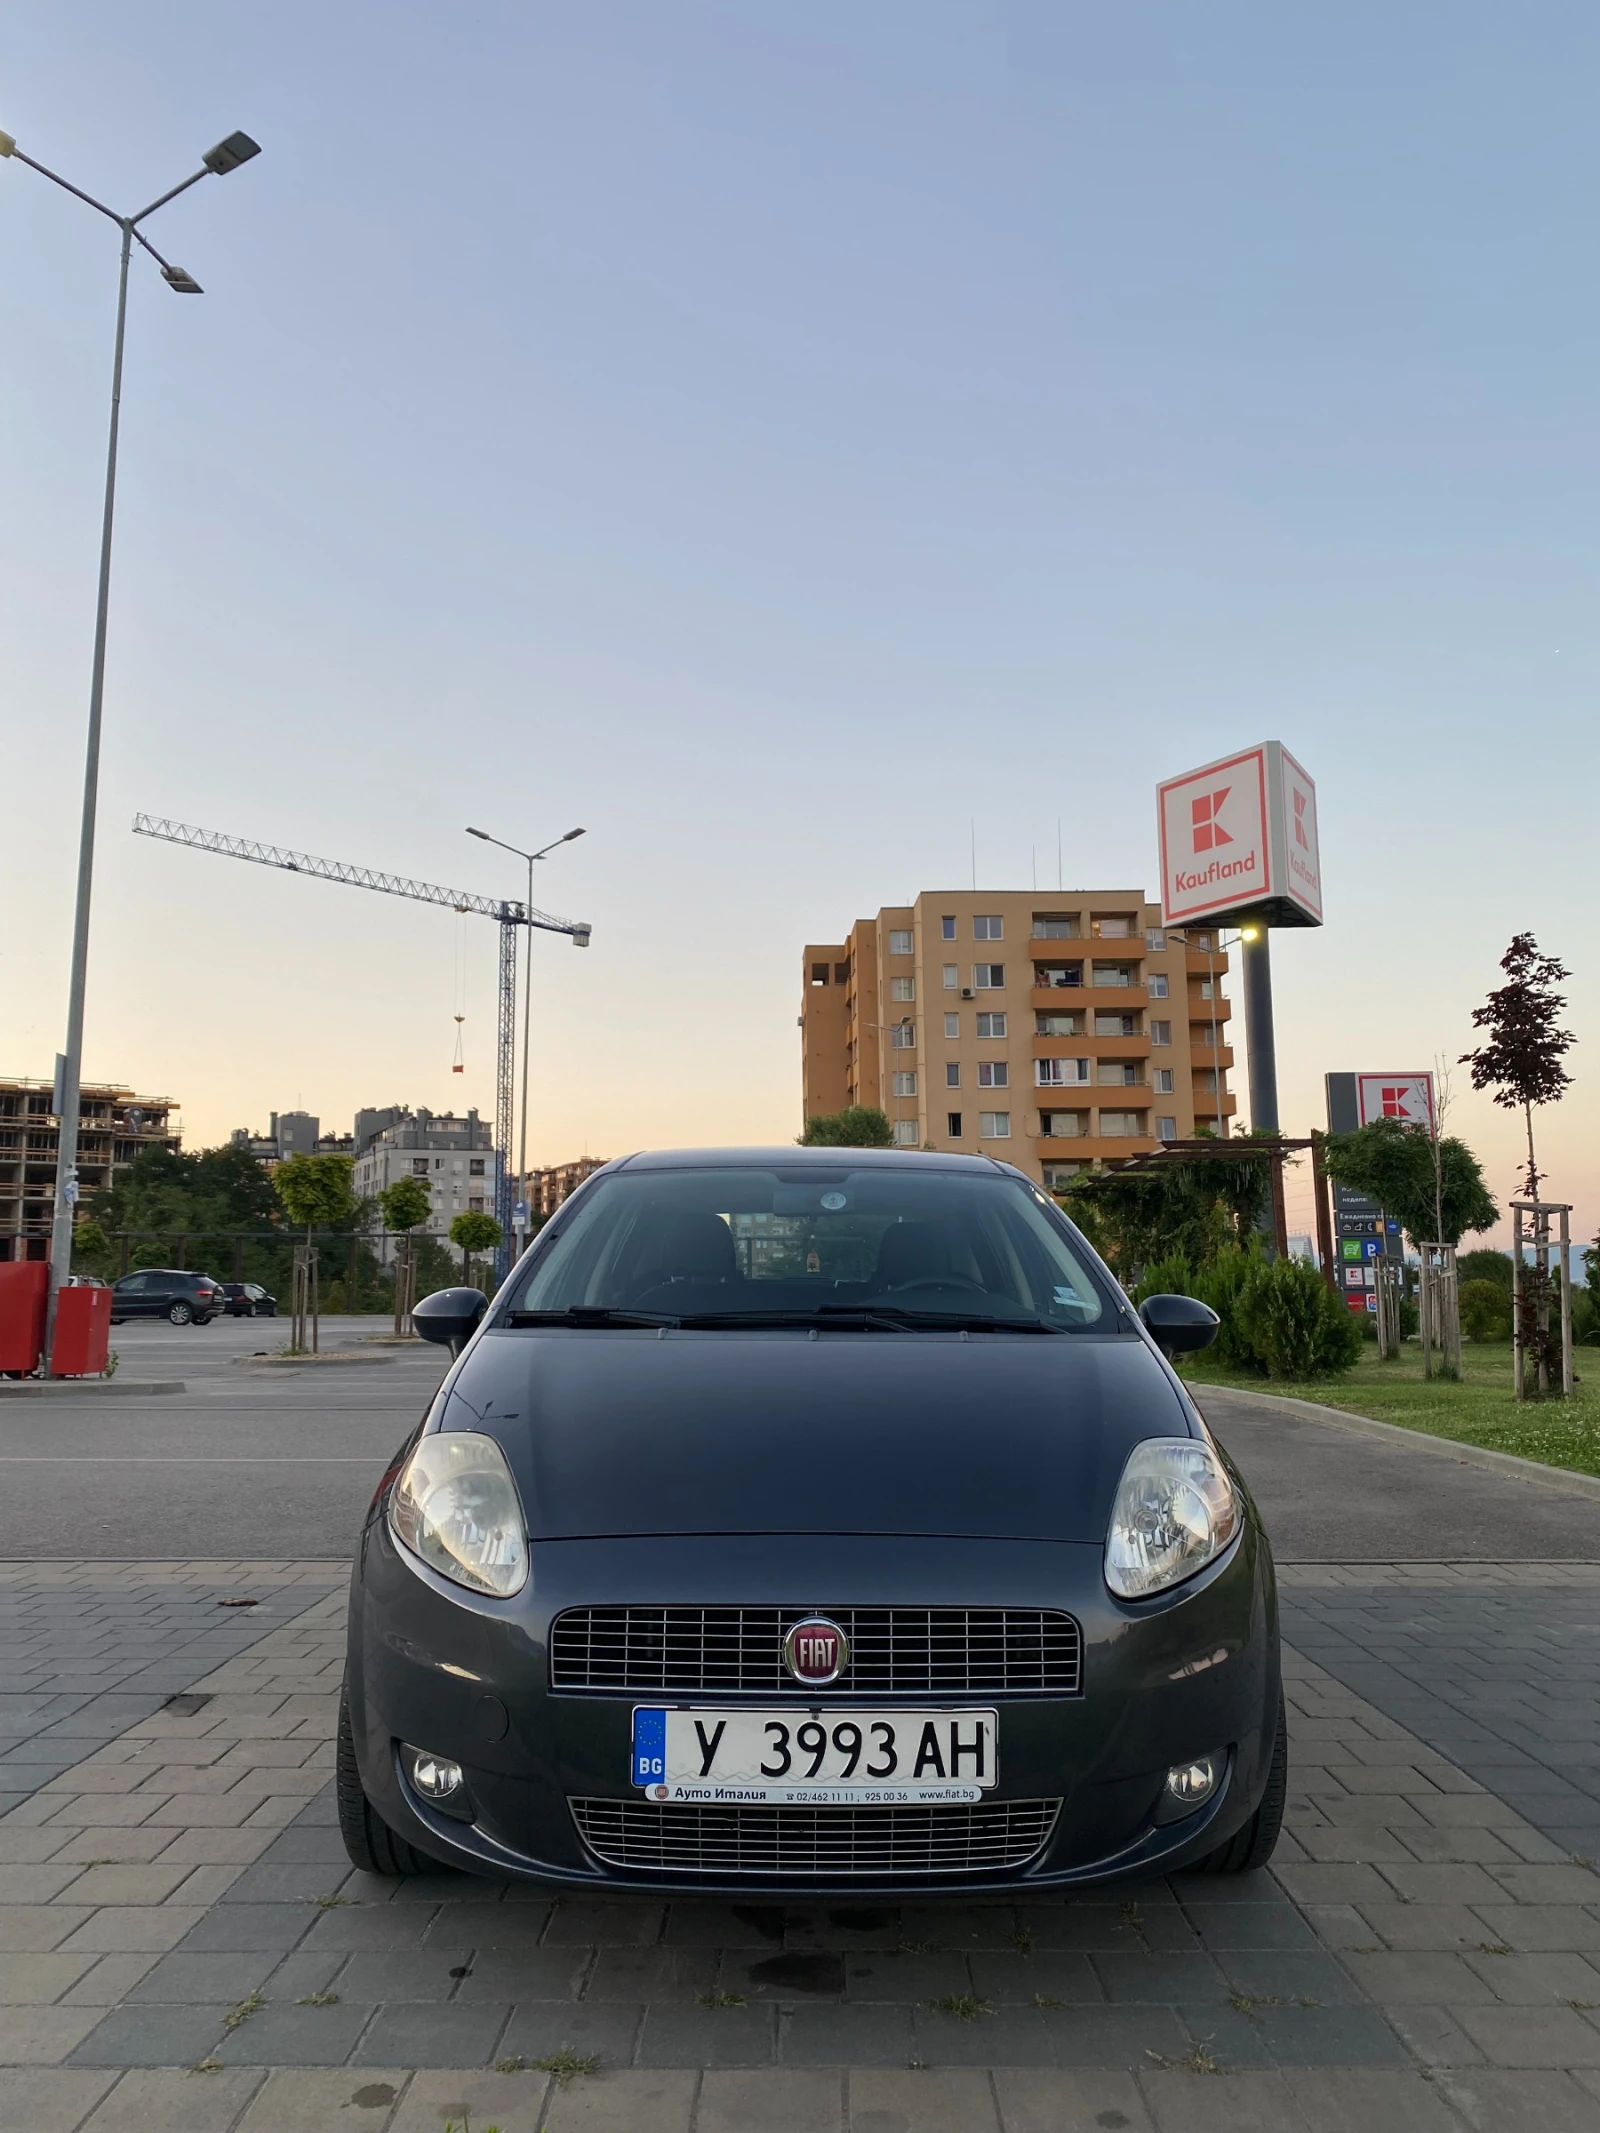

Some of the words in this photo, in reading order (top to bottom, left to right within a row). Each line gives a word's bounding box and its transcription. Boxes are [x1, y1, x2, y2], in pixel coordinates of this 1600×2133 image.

[1175, 850, 1255, 892] Kaufland
[800, 1638, 836, 1668] FIAT
[760, 1721, 898, 1778] 3993
[913, 1721, 985, 1778] AH
[639, 1758, 662, 1775] BG
[715, 1788, 767, 1800] Италия
[797, 1792, 828, 1802] 02/462
[832, 1793, 841, 1802] 11
[865, 1792, 881, 1801] 925
[883, 1792, 895, 1801] 00
[897, 1792, 908, 1801] 36
[919, 1789, 975, 1800] www.fiat.bg
